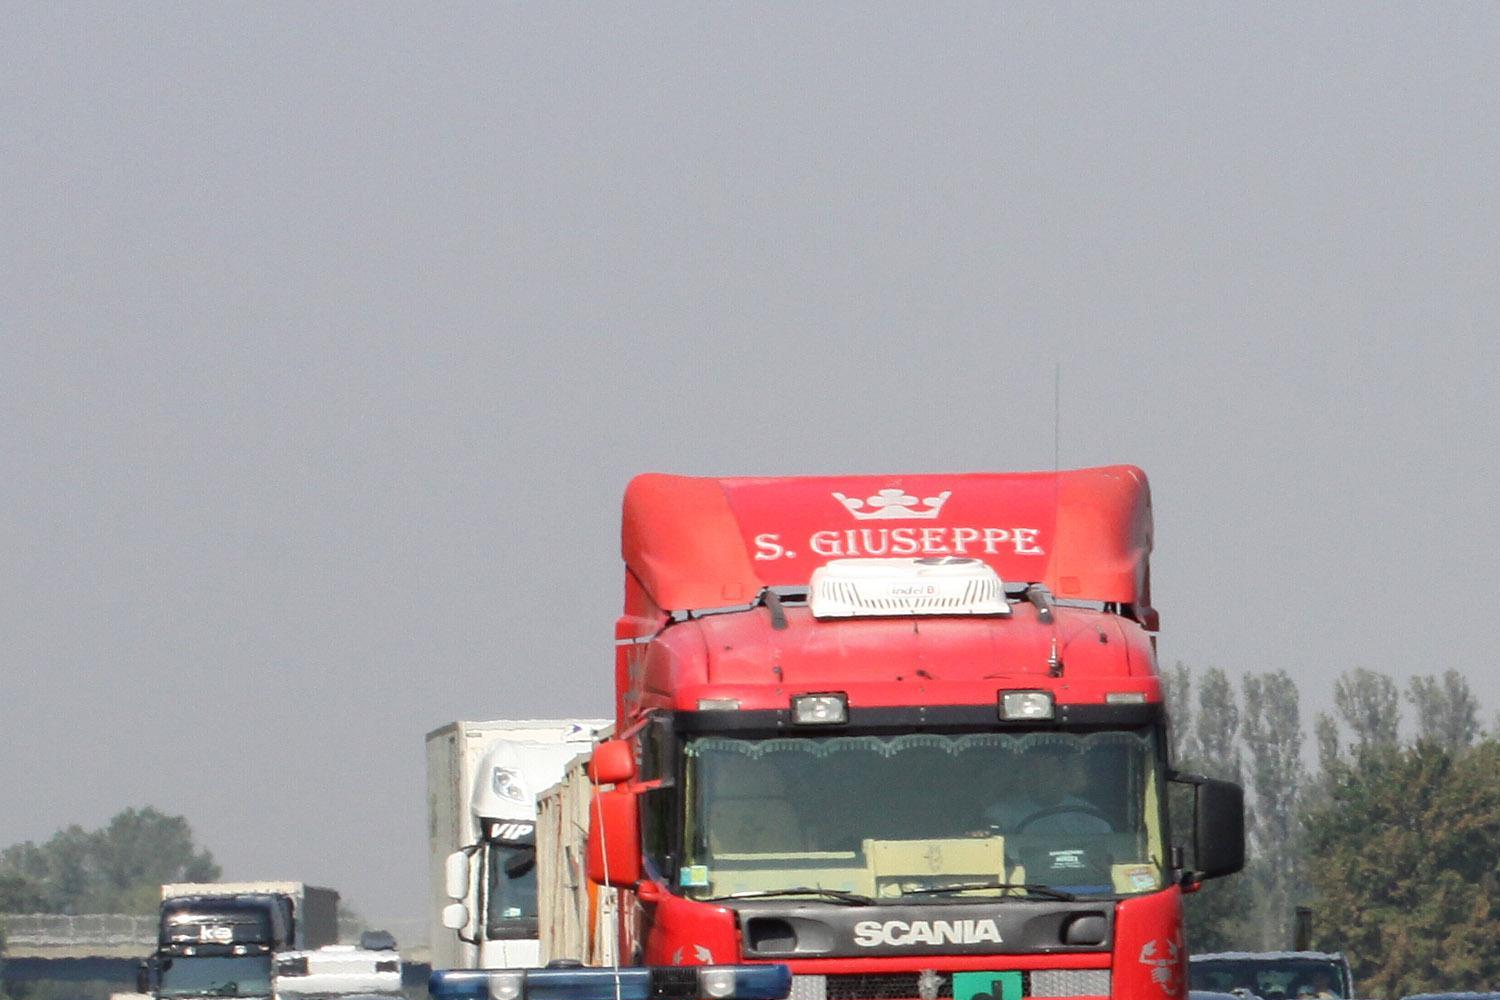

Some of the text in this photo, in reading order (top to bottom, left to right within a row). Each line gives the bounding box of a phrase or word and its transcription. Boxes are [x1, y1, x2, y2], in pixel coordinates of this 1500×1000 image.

[754, 527, 1045, 561] S. GIUSEPPE
[491, 823, 534, 840] VIP
[854, 919, 1003, 947] SCANIA
